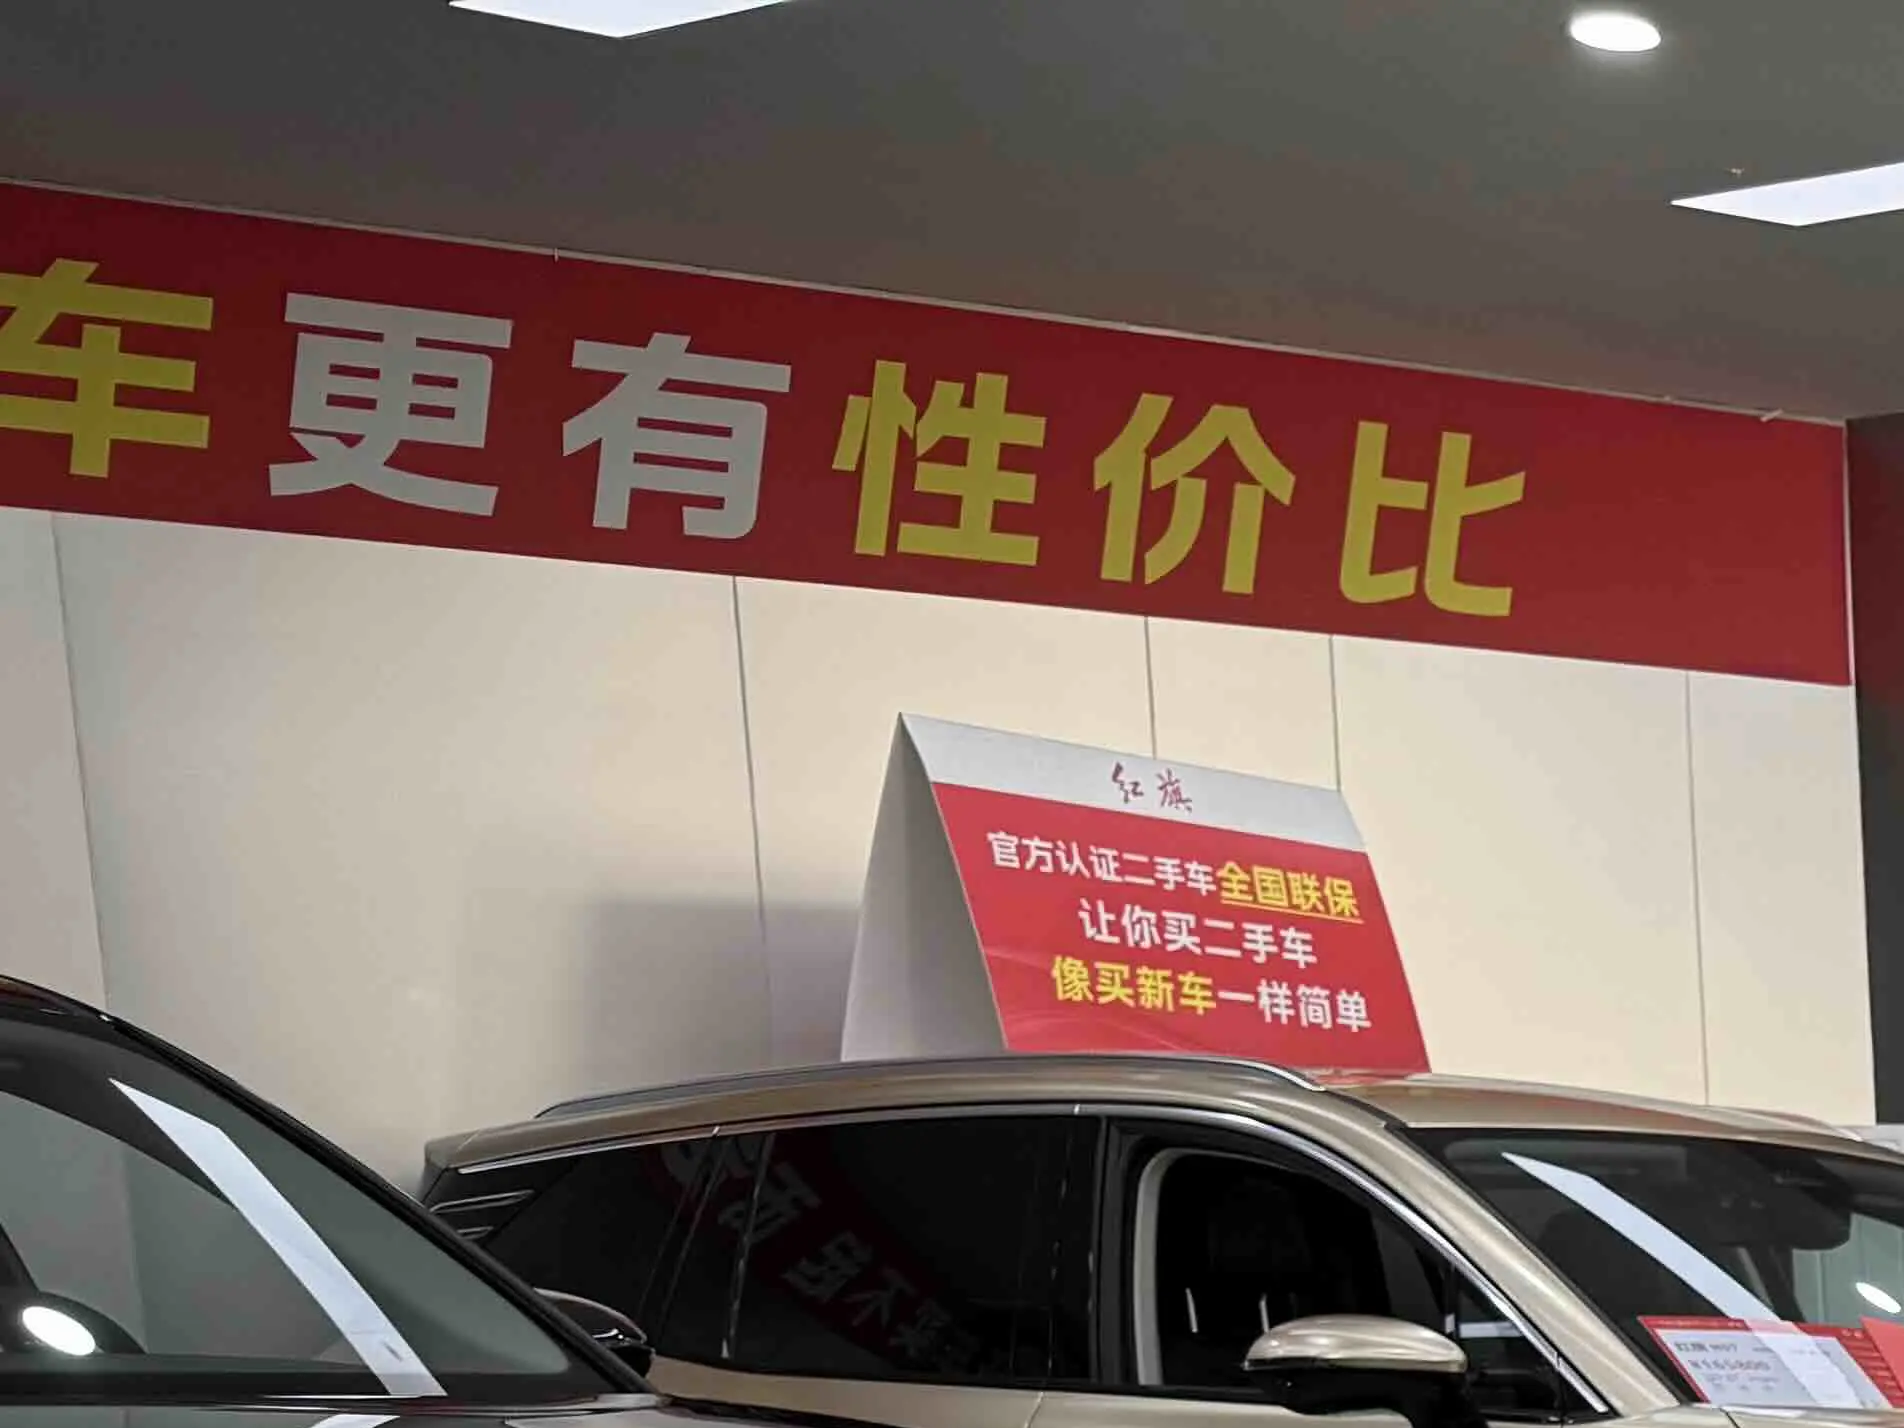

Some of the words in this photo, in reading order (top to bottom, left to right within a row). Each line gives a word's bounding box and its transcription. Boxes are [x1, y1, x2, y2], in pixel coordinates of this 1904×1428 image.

[0, 257, 1529, 618] 车更有性价比
[1111, 761, 1193, 813] 红旗
[1077, 898, 1318, 969] 让你买二手车
[1051, 955, 1373, 1034] 像买新车一样简单
